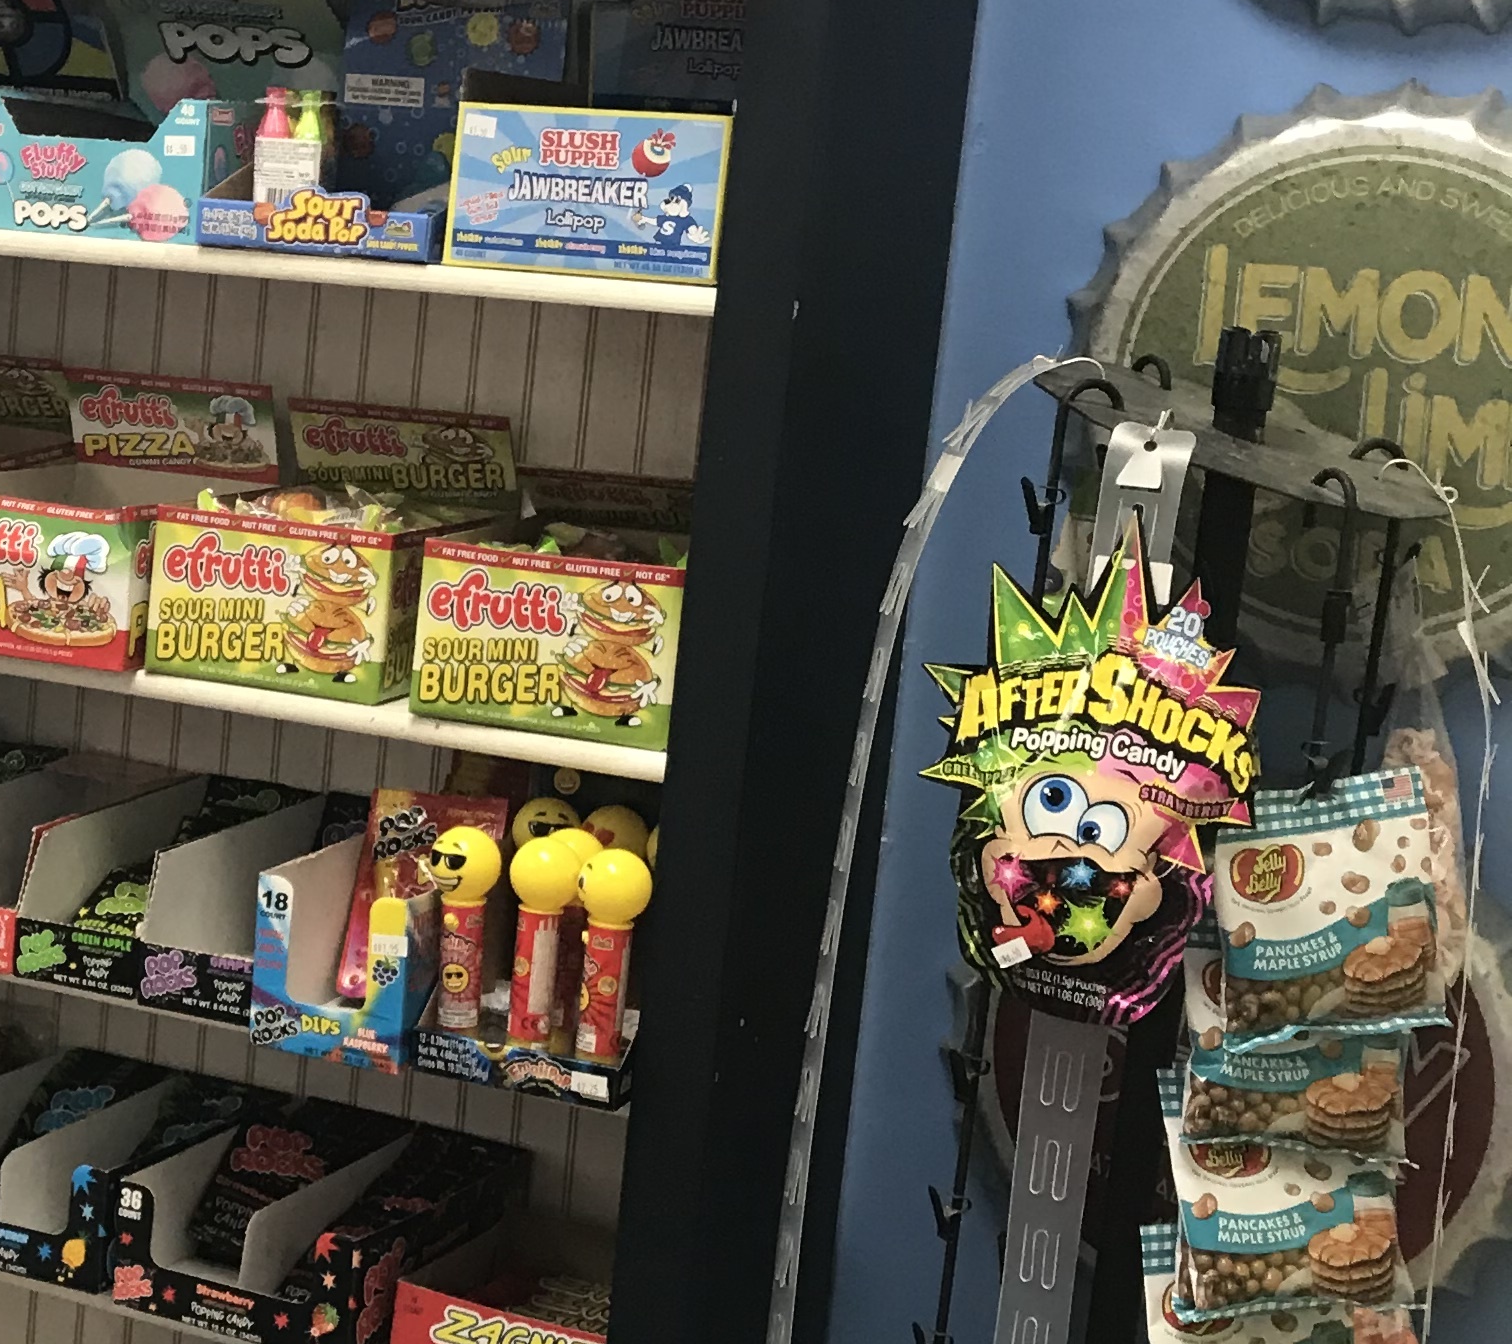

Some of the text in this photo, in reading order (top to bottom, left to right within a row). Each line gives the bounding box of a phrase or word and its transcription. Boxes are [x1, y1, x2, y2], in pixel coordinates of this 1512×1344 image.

[160, 20, 312, 65] POPS
[540, 130, 619, 151] SLUSH
[20, 142, 87, 174] Fluffy
[31, 159, 69, 180] Stuff
[508, 170, 649, 209] JAWBREAKER
[13, 200, 89, 232] POPS
[546, 208, 606, 233] Lollipop
[1234, 175, 1512, 239] DELICIOUS AND SWEE
[84, 433, 196, 457] PIZZA
[163, 532, 291, 595] efrutti
[442, 547, 456, 557] FAT
[457, 549, 476, 560] FREE
[477, 552, 498, 563] FOOD
[512, 557, 529, 567] NUT
[530, 558, 551, 569] FREE
[565, 564, 598, 575] GLUTEN
[599, 566, 621, 578] FREE
[635, 570, 653, 580] NOT
[158, 597, 265, 623] SOUR MINI
[427, 570, 569, 637] efrutti
[1167, 605, 1203, 637] 20
[156, 623, 285, 663] BURGER
[422, 637, 539, 663] SOUR MINI
[418, 664, 562, 706] BURGER
[1010, 725, 1188, 780] Popping Candy
[1138, 784, 1237, 820] STRAWBERRY
[261, 888, 290, 913] 18
[71, 931, 133, 953] GREEN APPLE
[1254, 931, 1339, 959] PANCAKES &
[1253, 942, 1343, 972] MAPLE SYRUP
[1027, 980, 1042, 994] NET
[1043, 983, 1056, 997] WT
[1073, 992, 1085, 1006] OZ
[253, 1005, 286, 1027] POP
[299, 1013, 342, 1037] DIPS
[249, 1018, 300, 1046] ROCKS
[119, 1187, 143, 1210] 36
[1217, 1223, 1307, 1245] MAPLE SYRUP
[1218, 1212, 1303, 1231] PANCAKES &
[196, 1282, 256, 1311] Strawberry
[190, 1300, 256, 1331] POPPING CANDY
